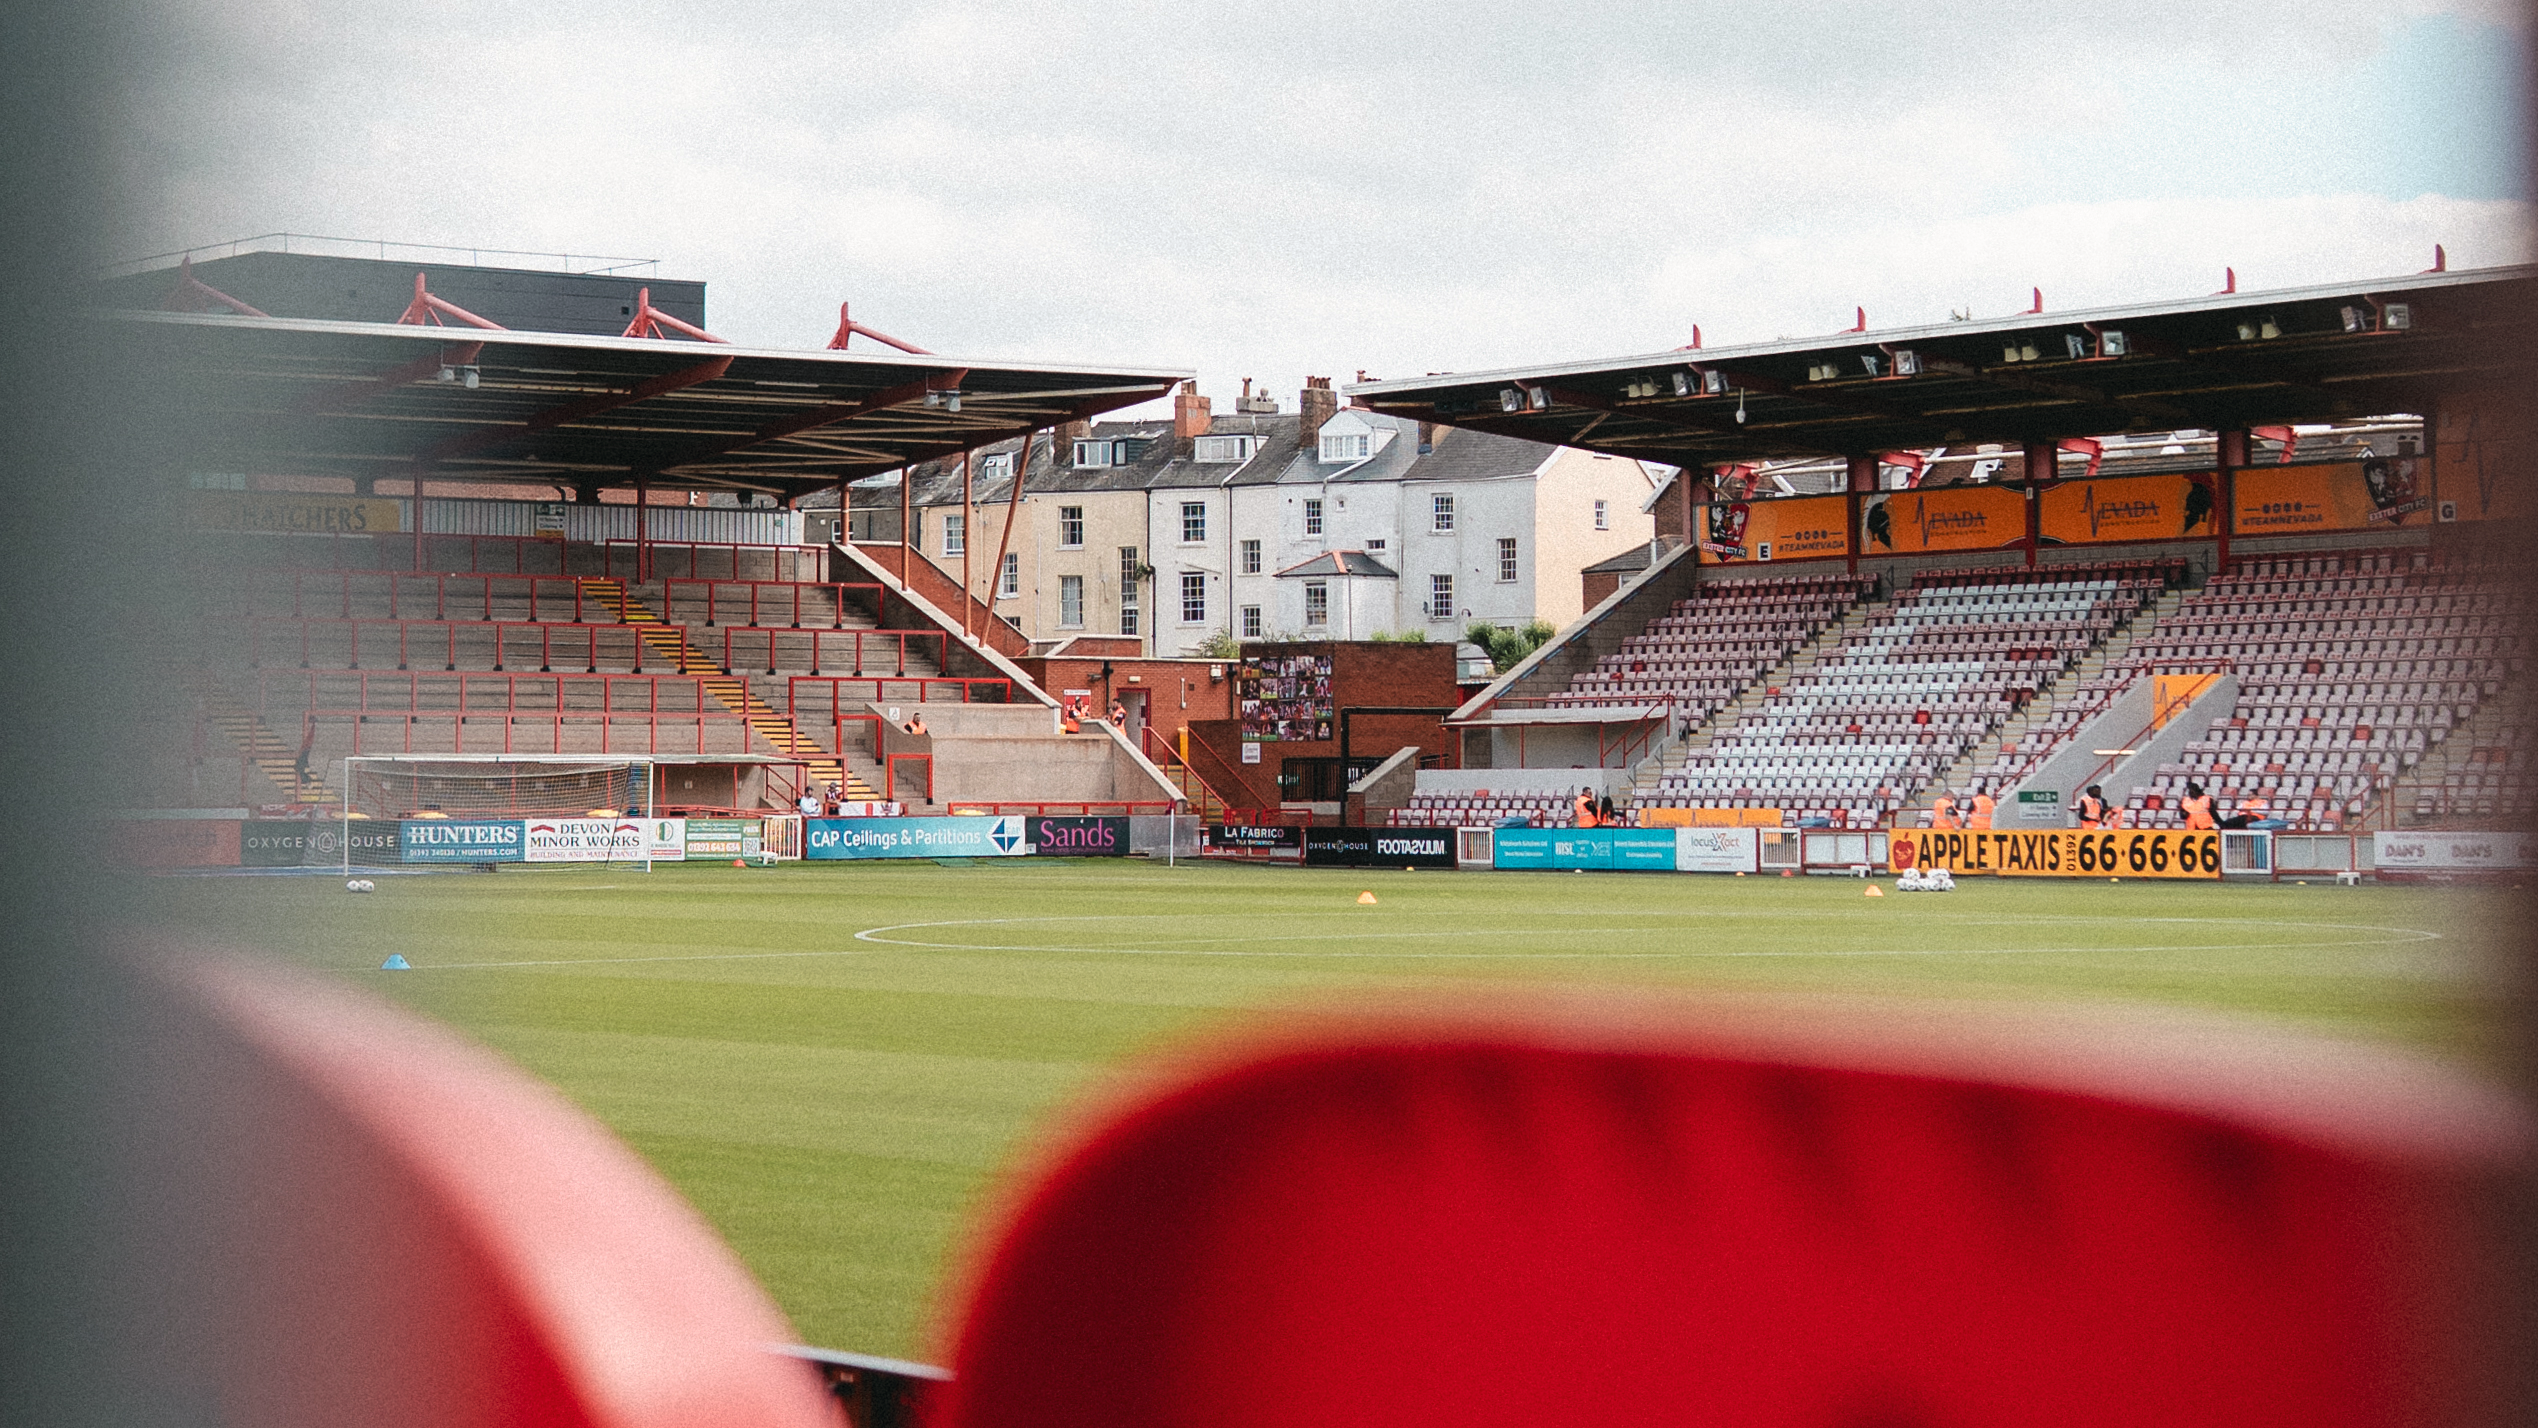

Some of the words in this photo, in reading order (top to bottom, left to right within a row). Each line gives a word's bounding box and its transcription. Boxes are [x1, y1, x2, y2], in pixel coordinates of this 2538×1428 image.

[2441, 504, 2455, 519] G
[1760, 545, 1769, 558] E
[408, 826, 518, 844] HUNTERS
[560, 824, 611, 834] DEVON
[1040, 818, 1115, 847] Sands
[1224, 826, 1238, 838] LA
[1240, 826, 1285, 838] FABRICO
[247, 837, 317, 849] OXYGEN
[338, 836, 395, 848] HOUSE
[530, 837, 580, 848] MINOR
[586, 836, 640, 847] WORKS
[811, 830, 840, 847] CAP
[843, 829, 897, 850] Ceilings
[901, 829, 912, 845] &
[915, 828, 981, 845] Partitions
[462, 848, 518, 857] HUNTERS.COM
[1308, 842, 1336, 850] OXYGEN
[1346, 842, 1369, 850] HOUSE
[1918, 833, 1988, 869] APPLE
[1994, 834, 2060, 871] TAXIS
[2066, 833, 2076, 872] 01392
[530, 851, 566, 859] BUILDING
